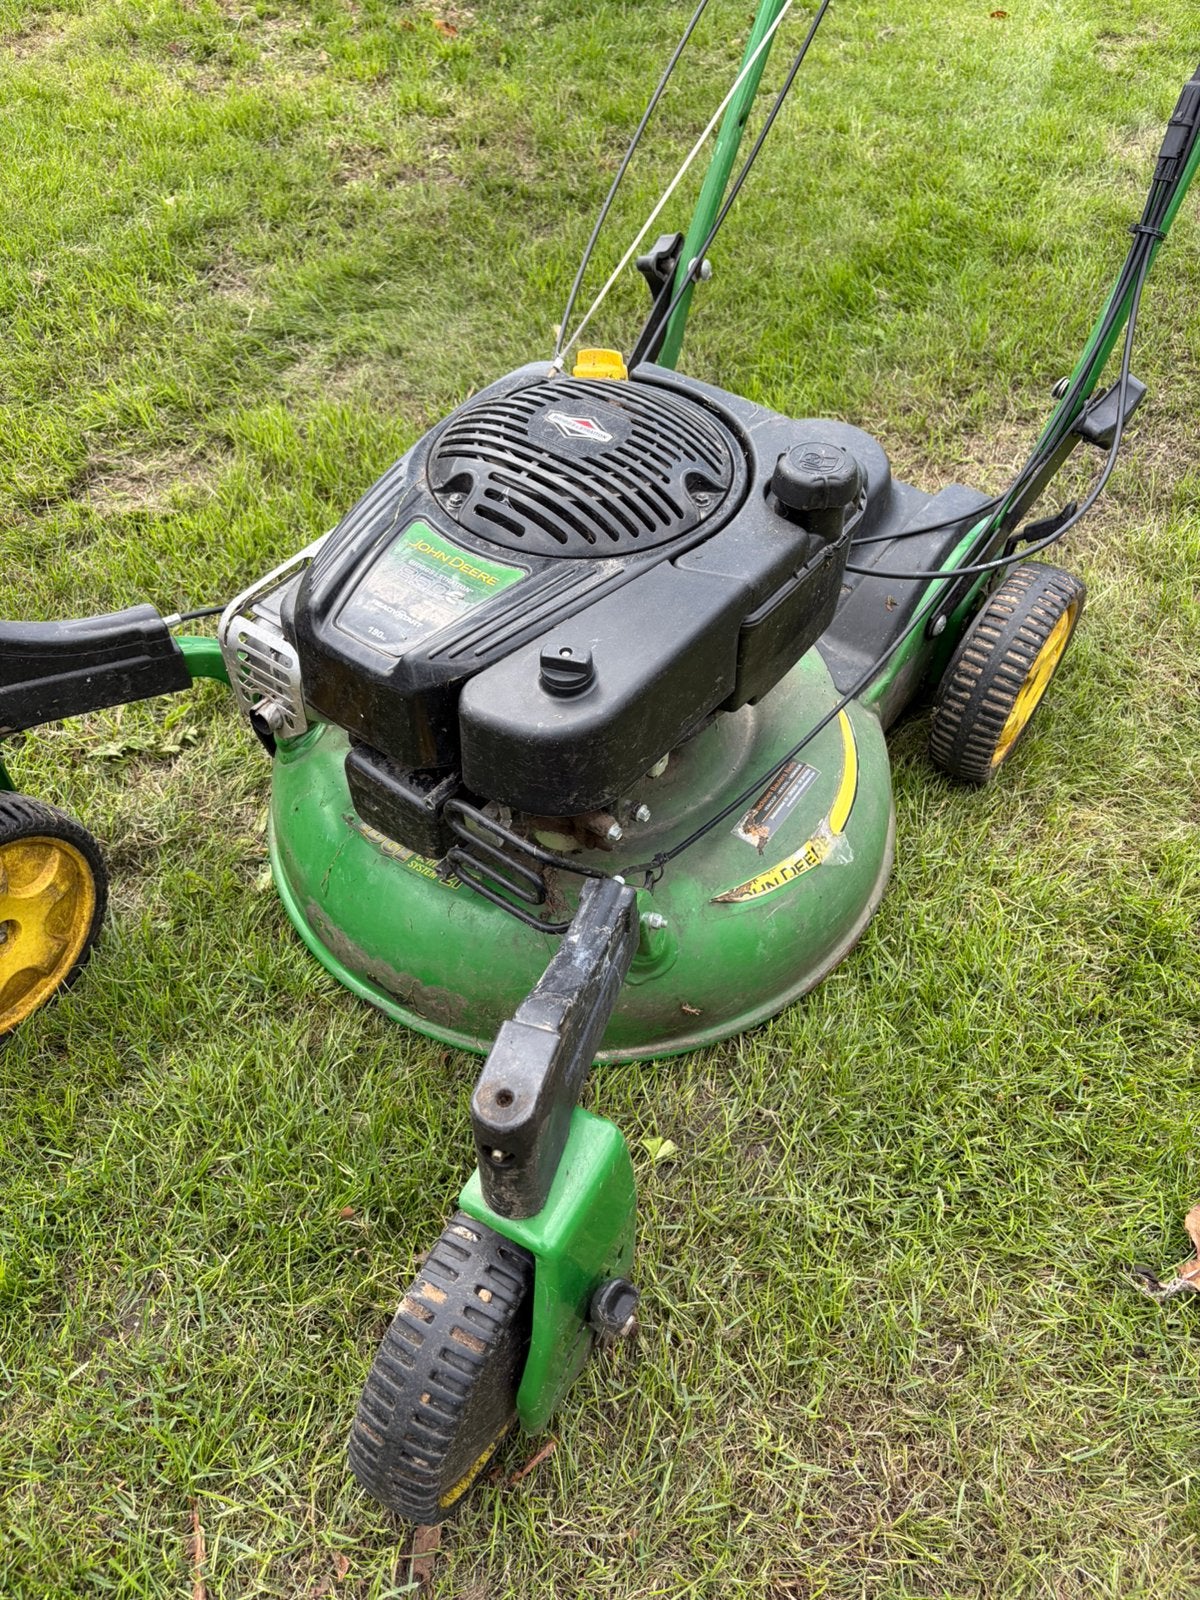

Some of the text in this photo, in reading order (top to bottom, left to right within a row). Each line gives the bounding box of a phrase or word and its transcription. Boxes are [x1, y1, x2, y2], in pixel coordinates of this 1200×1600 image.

[409, 539, 500, 587] JOHN DEERE
[407, 860, 438, 880] SYSTEM
